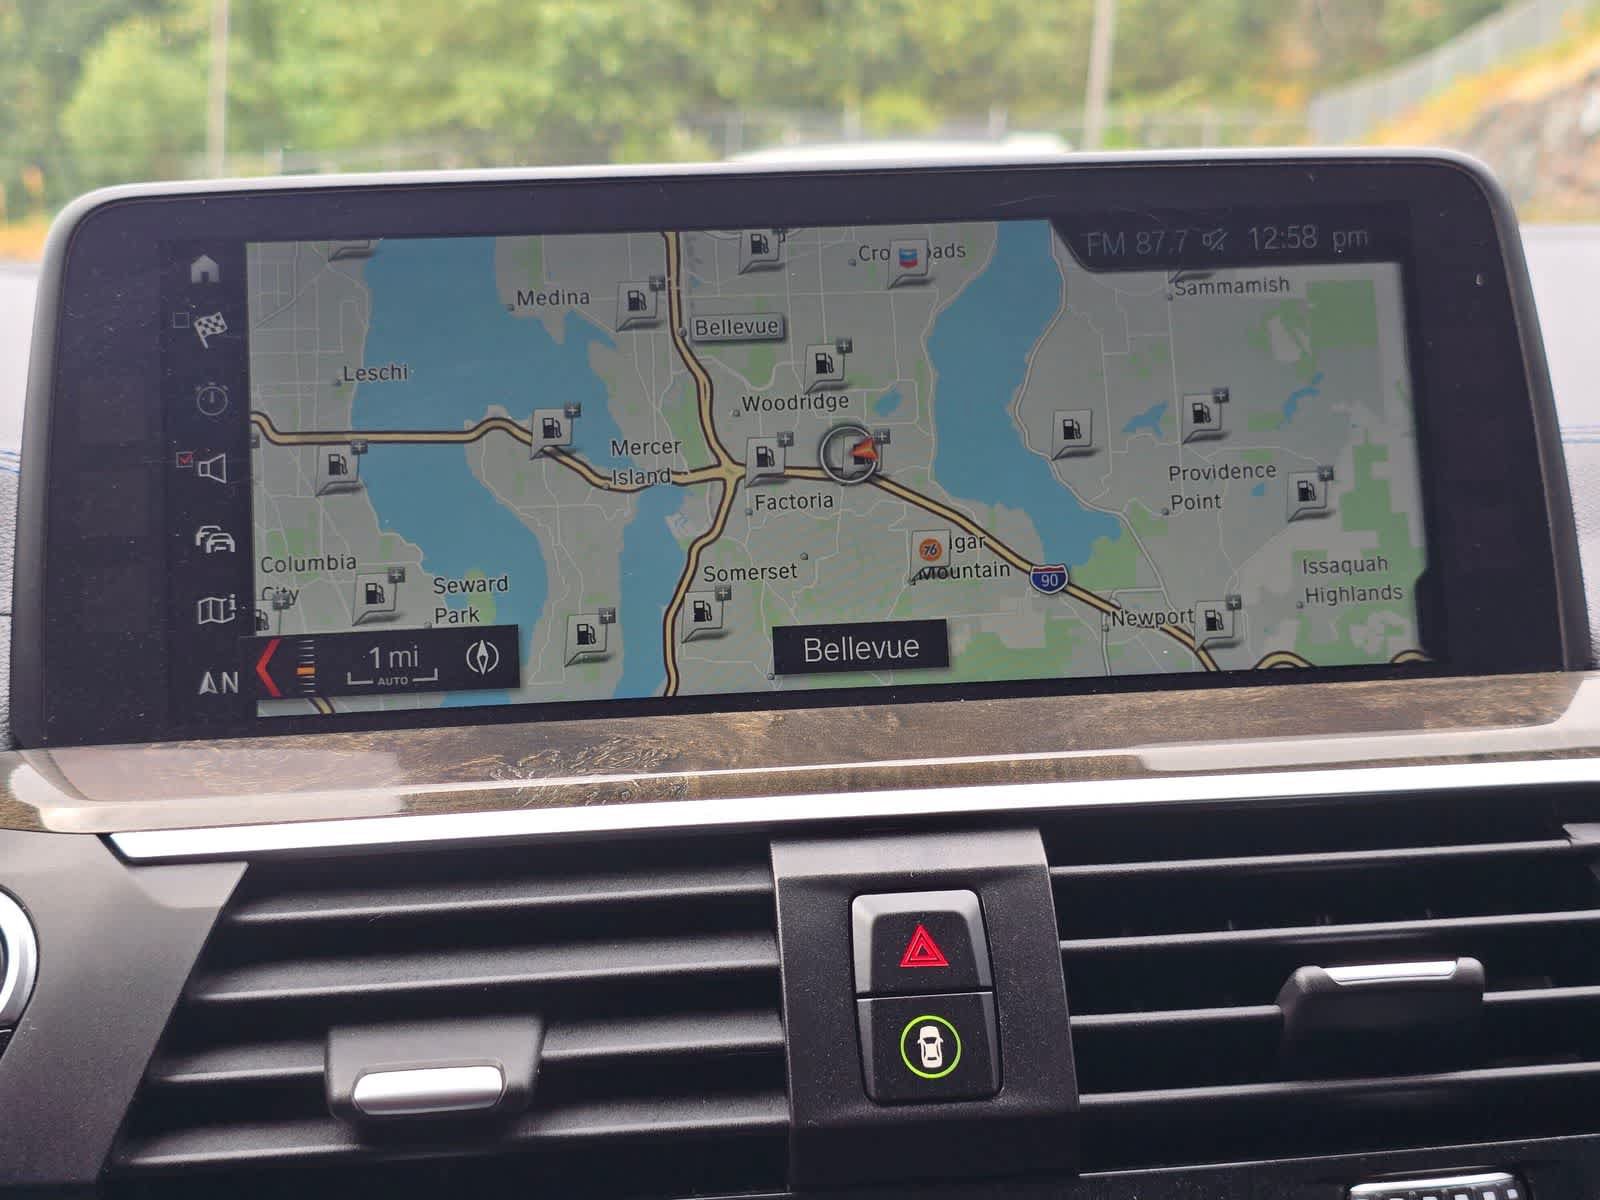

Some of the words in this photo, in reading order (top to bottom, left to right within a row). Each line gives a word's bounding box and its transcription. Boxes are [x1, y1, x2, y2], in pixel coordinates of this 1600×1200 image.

[1087, 233, 1125, 256] FM
[1136, 230, 1187, 254] 87.7
[1249, 226, 1318, 250] 12:58
[1332, 229, 1369, 251] pm
[1174, 277, 1291, 297] Sammamish
[516, 289, 591, 306] Medina
[695, 318, 779, 337] Bellevue
[343, 364, 408, 383] Leschi
[742, 392, 850, 414] Woodridge
[611, 439, 682, 457] Mercer
[612, 467, 672, 485] Island
[1168, 463, 1278, 482] Providence
[755, 492, 834, 511] Factoria
[1171, 493, 1222, 511] Point
[261, 555, 357, 574] Columbia
[704, 562, 798, 583] Somerset
[1303, 556, 1389, 576] Issaquah
[433, 575, 509, 594] Seward
[1041, 574, 1058, 587] 90
[1305, 585, 1403, 606] Highlands
[435, 606, 481, 624] Park
[1111, 608, 1195, 627] Newport
[369, 647, 381, 669] 1
[388, 645, 419, 669] mi
[804, 635, 920, 663] Bellevue
[378, 675, 409, 687] AUTO
